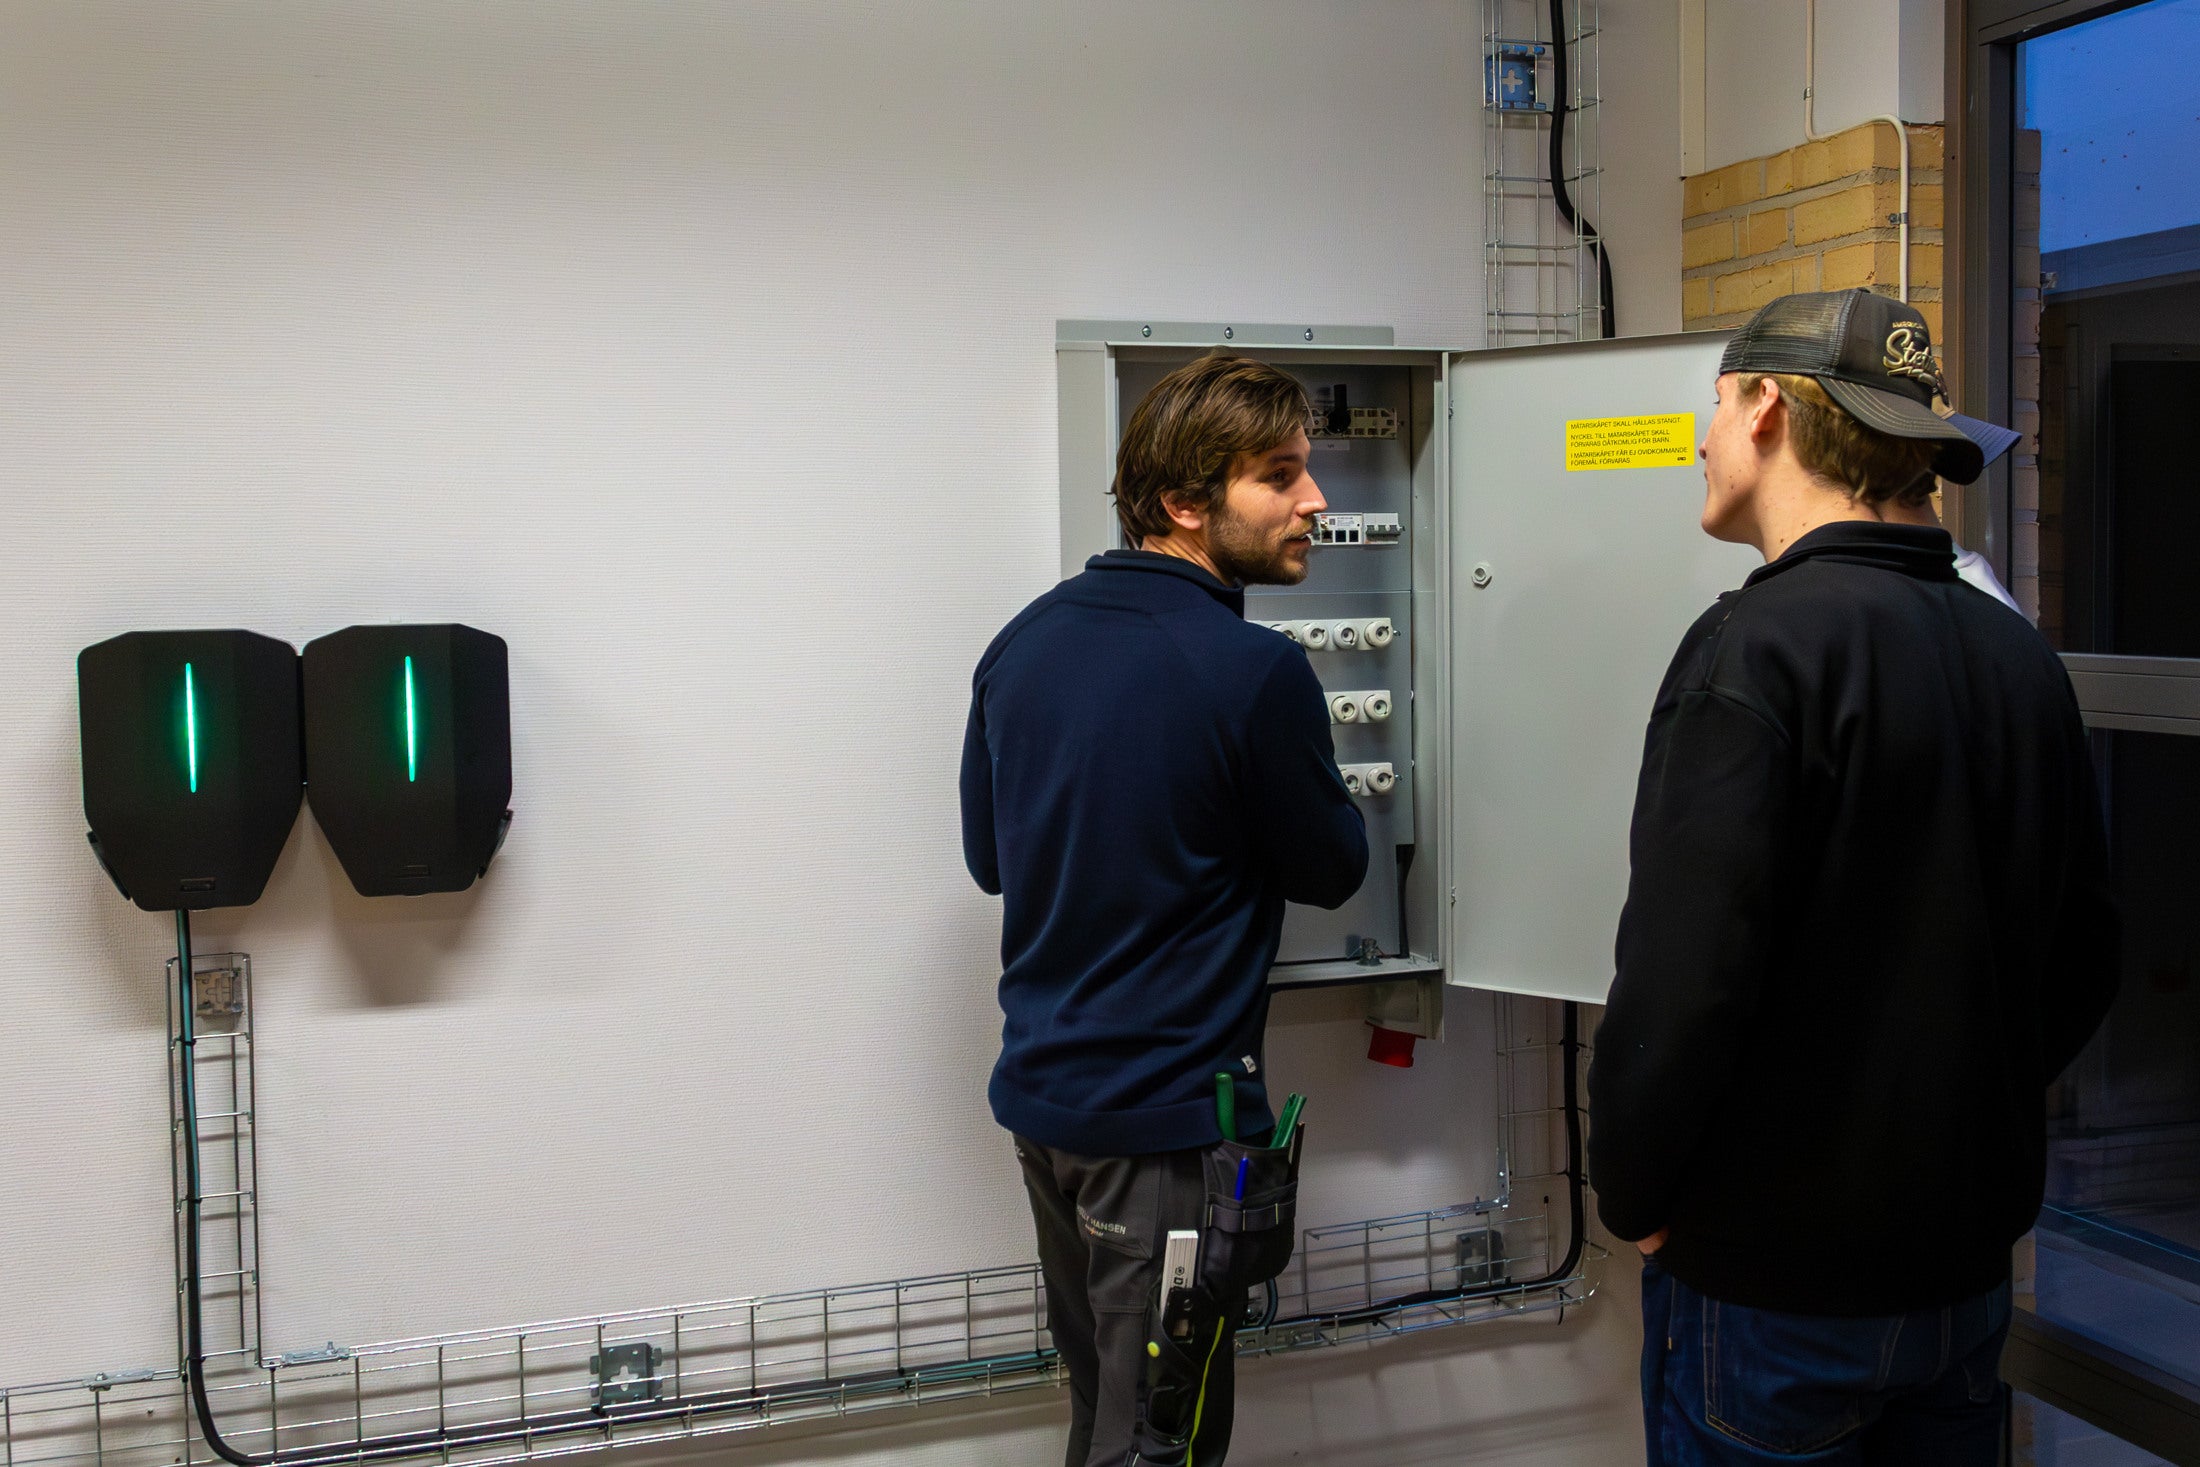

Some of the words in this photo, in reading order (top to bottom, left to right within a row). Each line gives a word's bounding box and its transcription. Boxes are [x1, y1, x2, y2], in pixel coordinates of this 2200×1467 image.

[1632, 418, 1656, 426] HÅLLAS
[1570, 433, 1593, 441] NYCKEL
[1652, 436, 1670, 444] BARN
